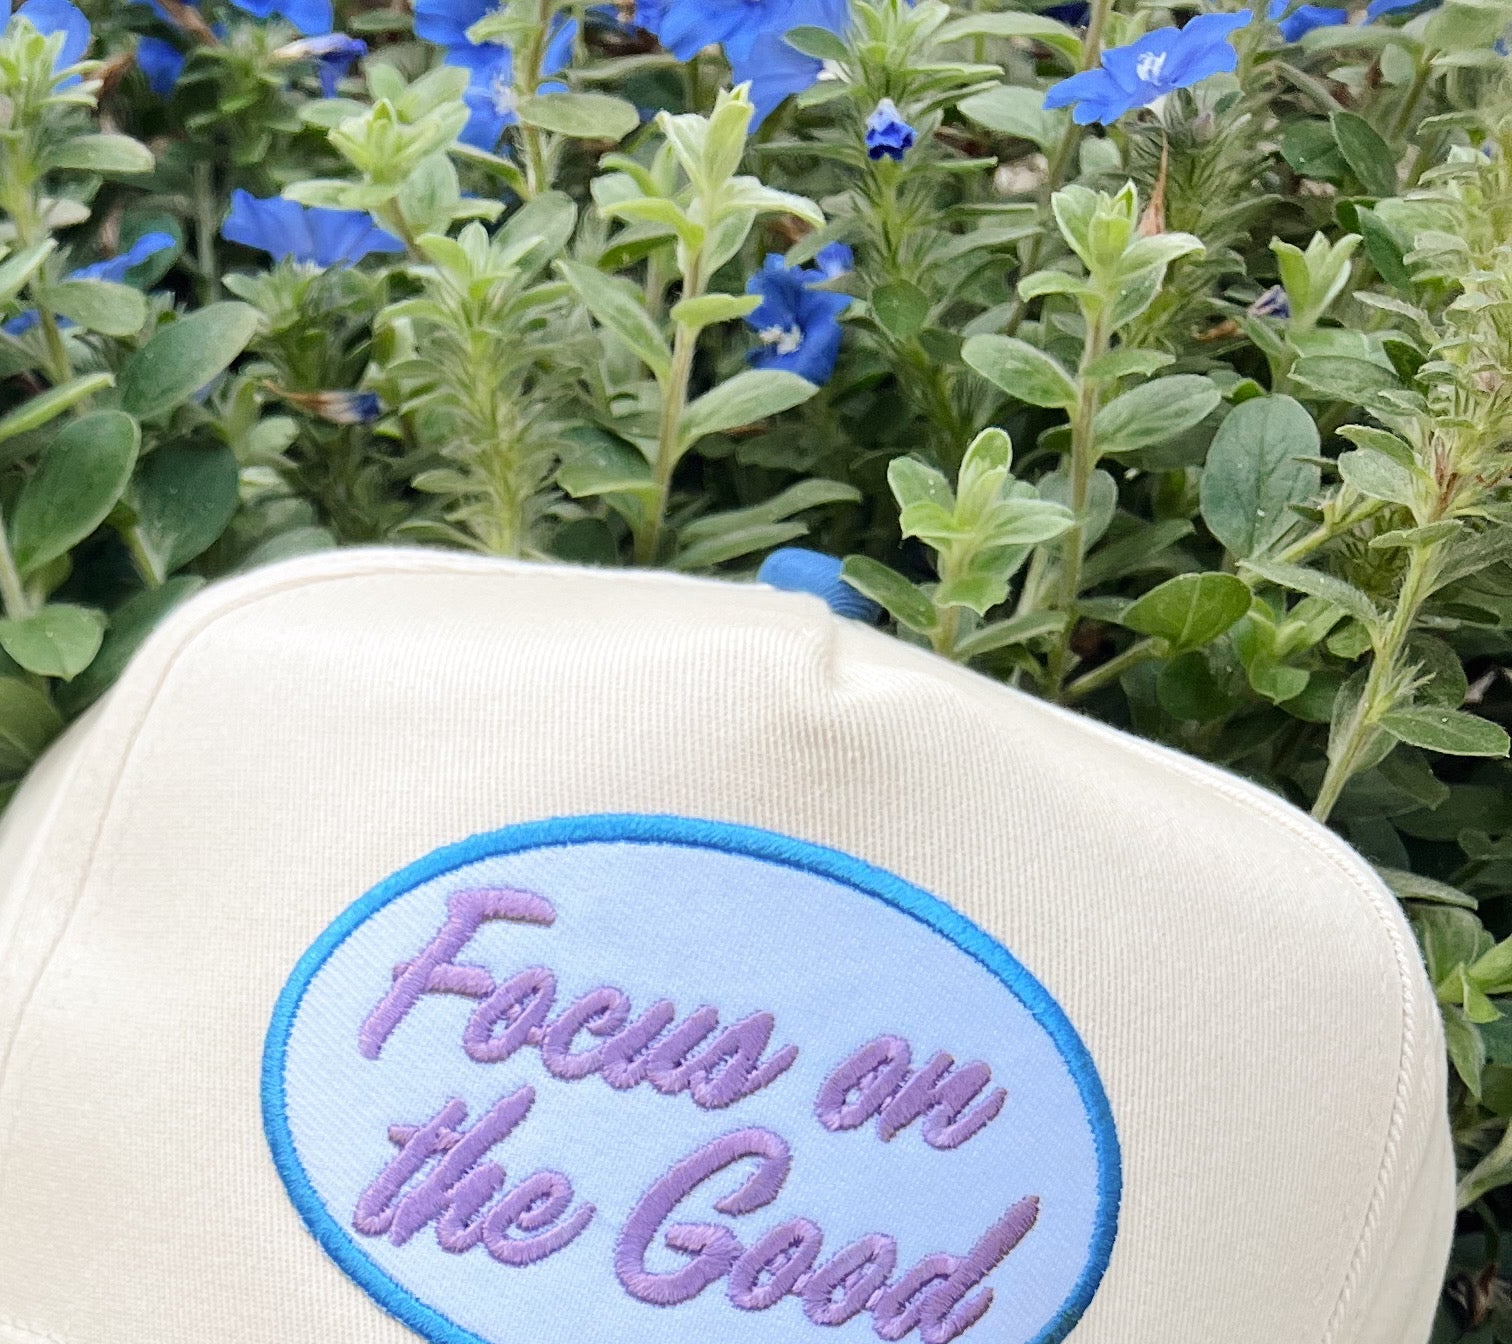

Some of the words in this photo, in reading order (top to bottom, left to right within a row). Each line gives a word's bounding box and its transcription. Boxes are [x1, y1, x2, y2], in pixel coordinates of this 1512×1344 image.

[357, 886, 799, 1110] Focus
[814, 1033, 1008, 1150] on
[352, 1084, 597, 1267] the
